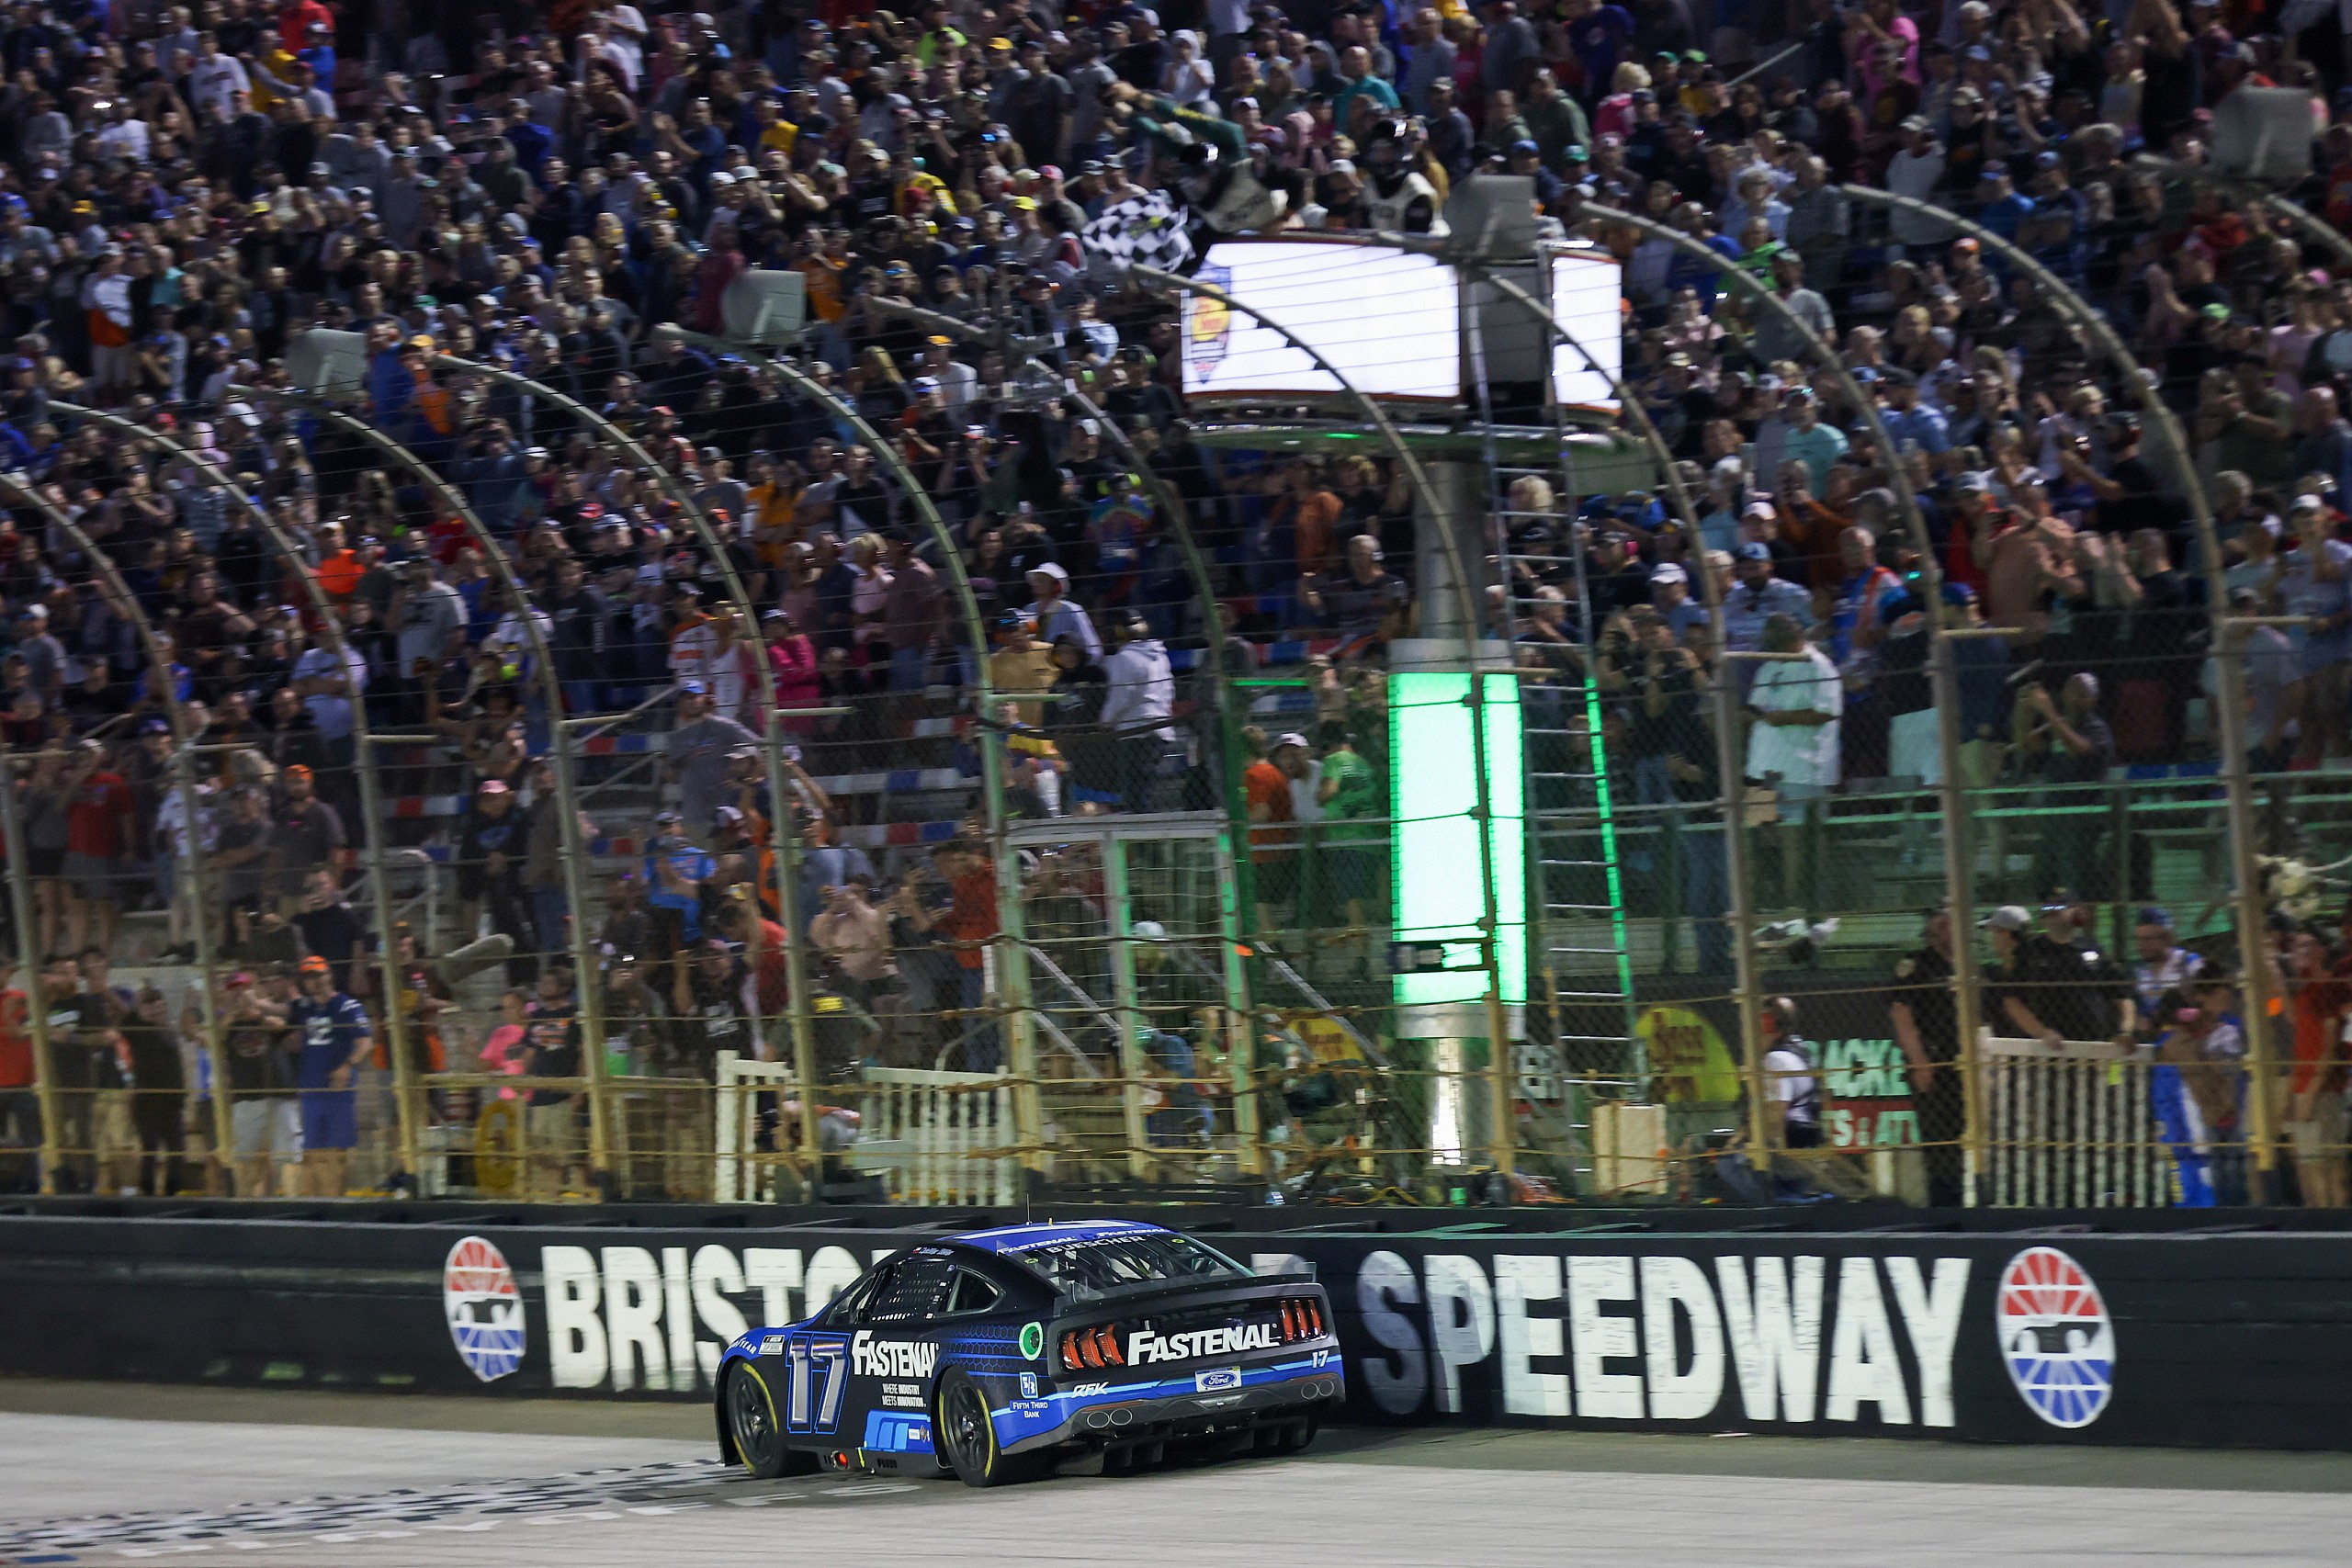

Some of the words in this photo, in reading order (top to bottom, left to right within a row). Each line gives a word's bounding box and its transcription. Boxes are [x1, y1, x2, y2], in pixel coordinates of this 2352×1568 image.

[999, 1235, 1077, 1254] FASTENAL
[1046, 1235, 1145, 1254] BUESCHER
[541, 1243, 897, 1393] BRIST
[1356, 1250, 1971, 1427] SPEEDWAY
[1127, 1323, 1281, 1367] FASTENAL
[1311, 1350, 1329, 1369] 17
[786, 1332, 851, 1433] 17
[882, 1383, 898, 1395] WHERE
[899, 1383, 920, 1395] INDUSTRY
[1208, 1374, 1229, 1385] Ford
[1071, 1382, 1109, 1398] RFK
[882, 1395, 898, 1406] MEETS
[1012, 1402, 1029, 1410] FIFTH
[1031, 1401, 1048, 1409] THIRD
[117, 1483, 922, 1558] PLAYOFFS
